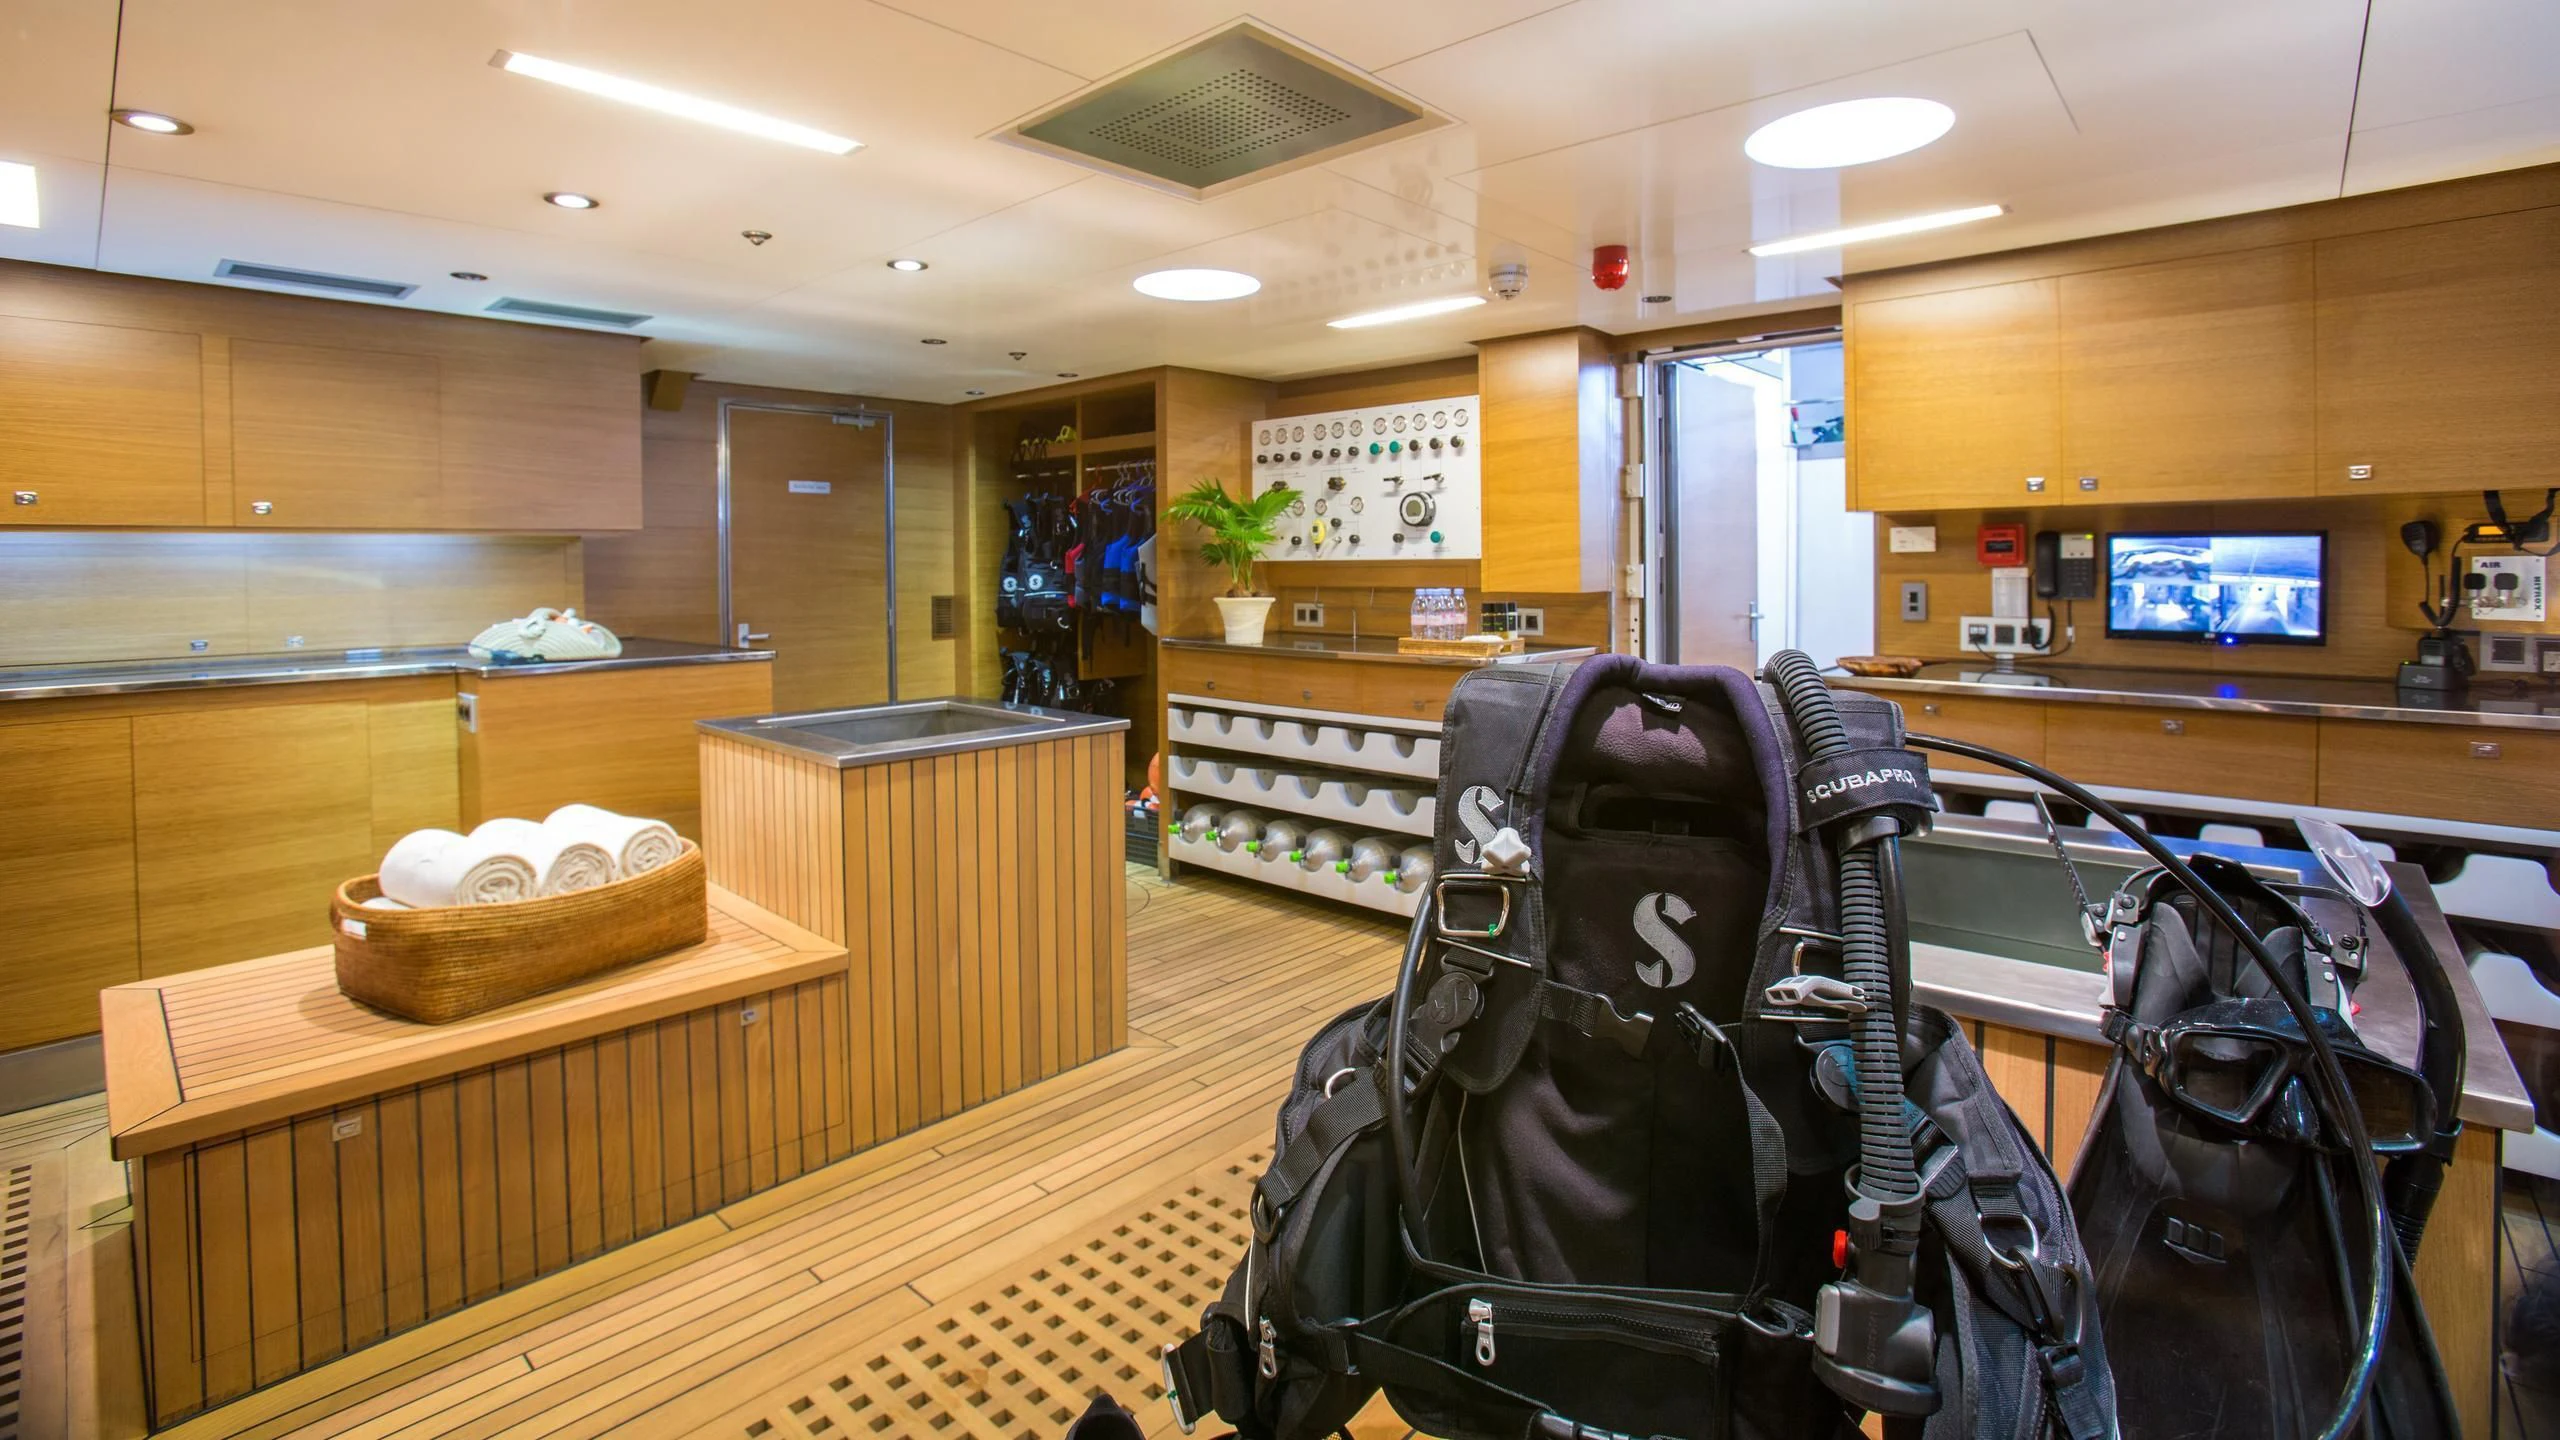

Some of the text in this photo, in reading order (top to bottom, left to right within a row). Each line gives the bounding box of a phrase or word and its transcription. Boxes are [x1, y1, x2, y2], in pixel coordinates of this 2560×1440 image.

[1454, 785, 1505, 865] S
[1806, 768, 1914, 804] SCUBAPRO
[1633, 892, 1697, 988] S
